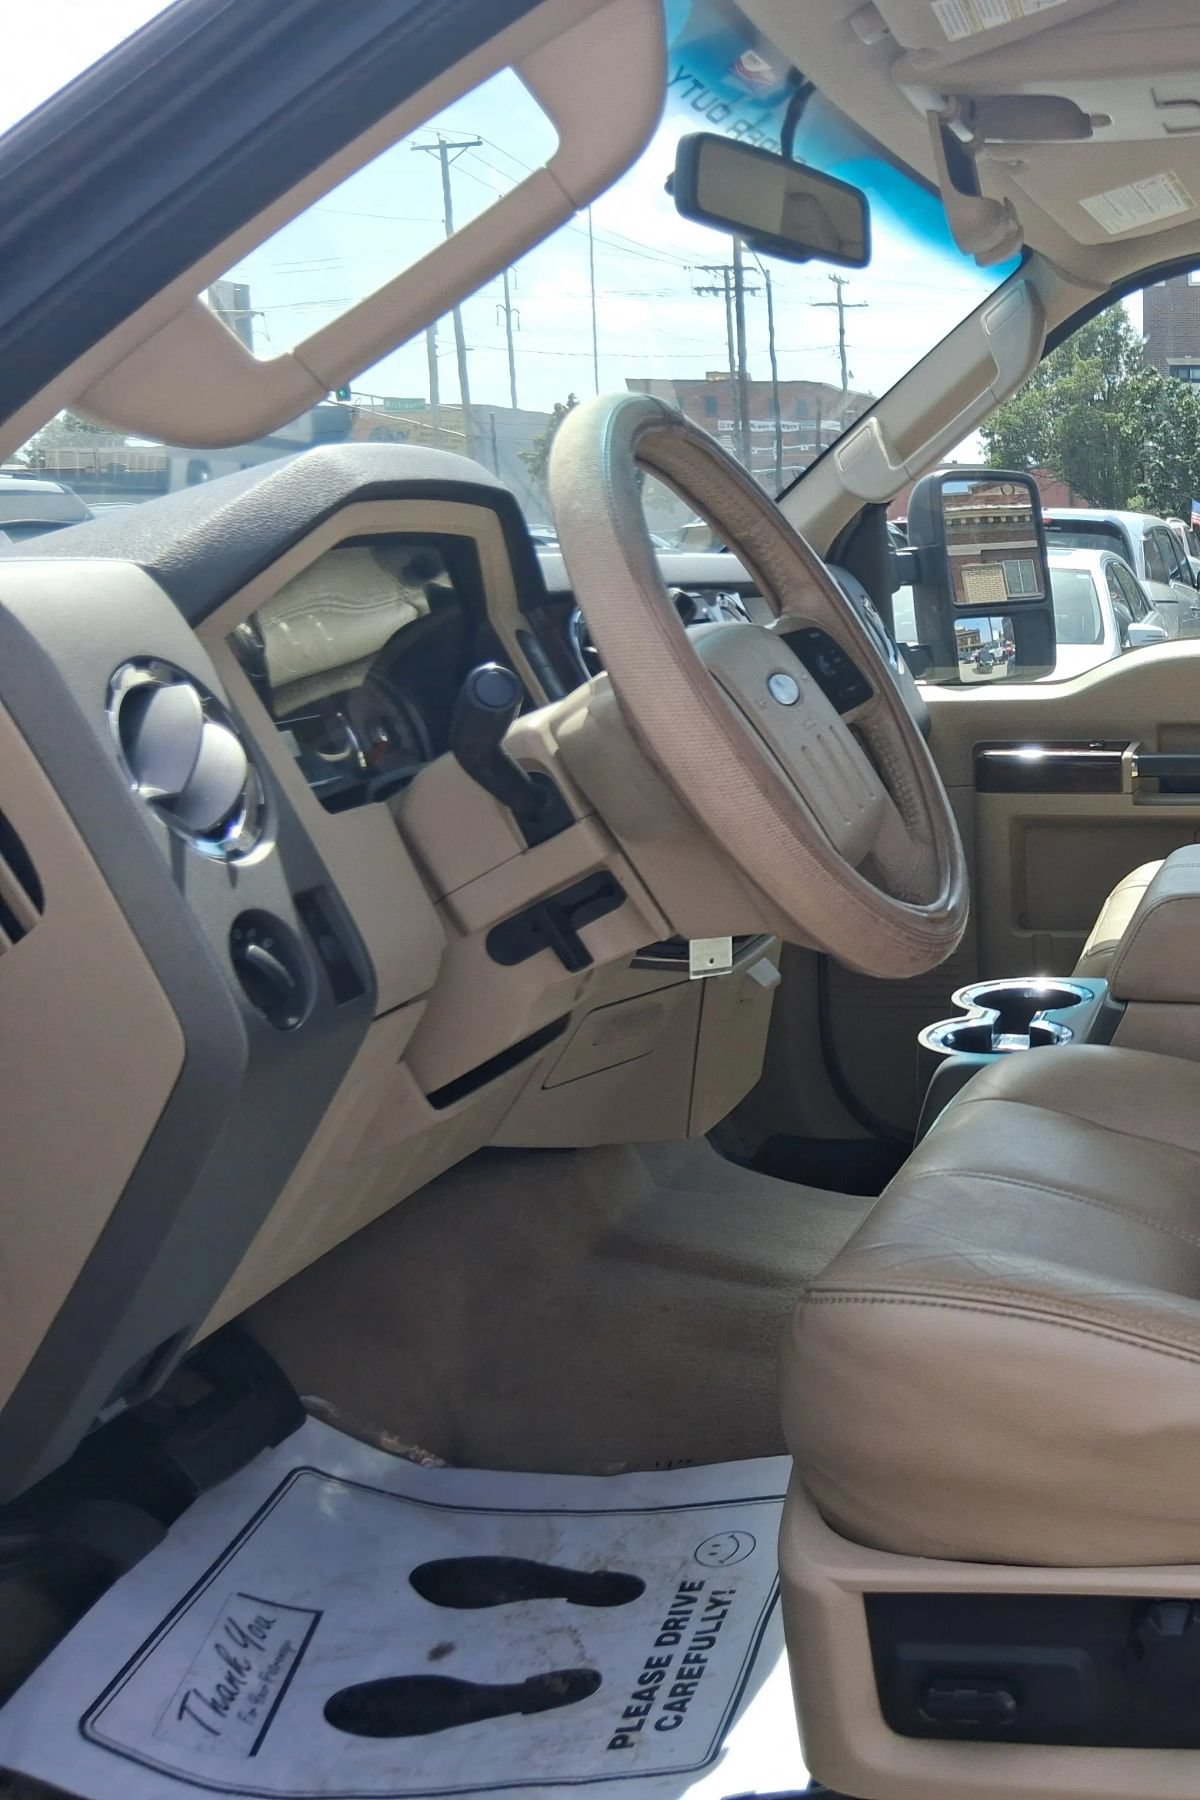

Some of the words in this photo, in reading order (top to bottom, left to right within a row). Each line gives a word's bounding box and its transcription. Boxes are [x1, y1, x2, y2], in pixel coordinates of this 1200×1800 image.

[177, 1642, 252, 1737] Thank
[224, 1615, 278, 1652] You
[607, 1654, 674, 1751] PLEASE
[653, 1579, 706, 1648] DRIVE
[653, 1589, 737, 1732] CAREFULLY!
